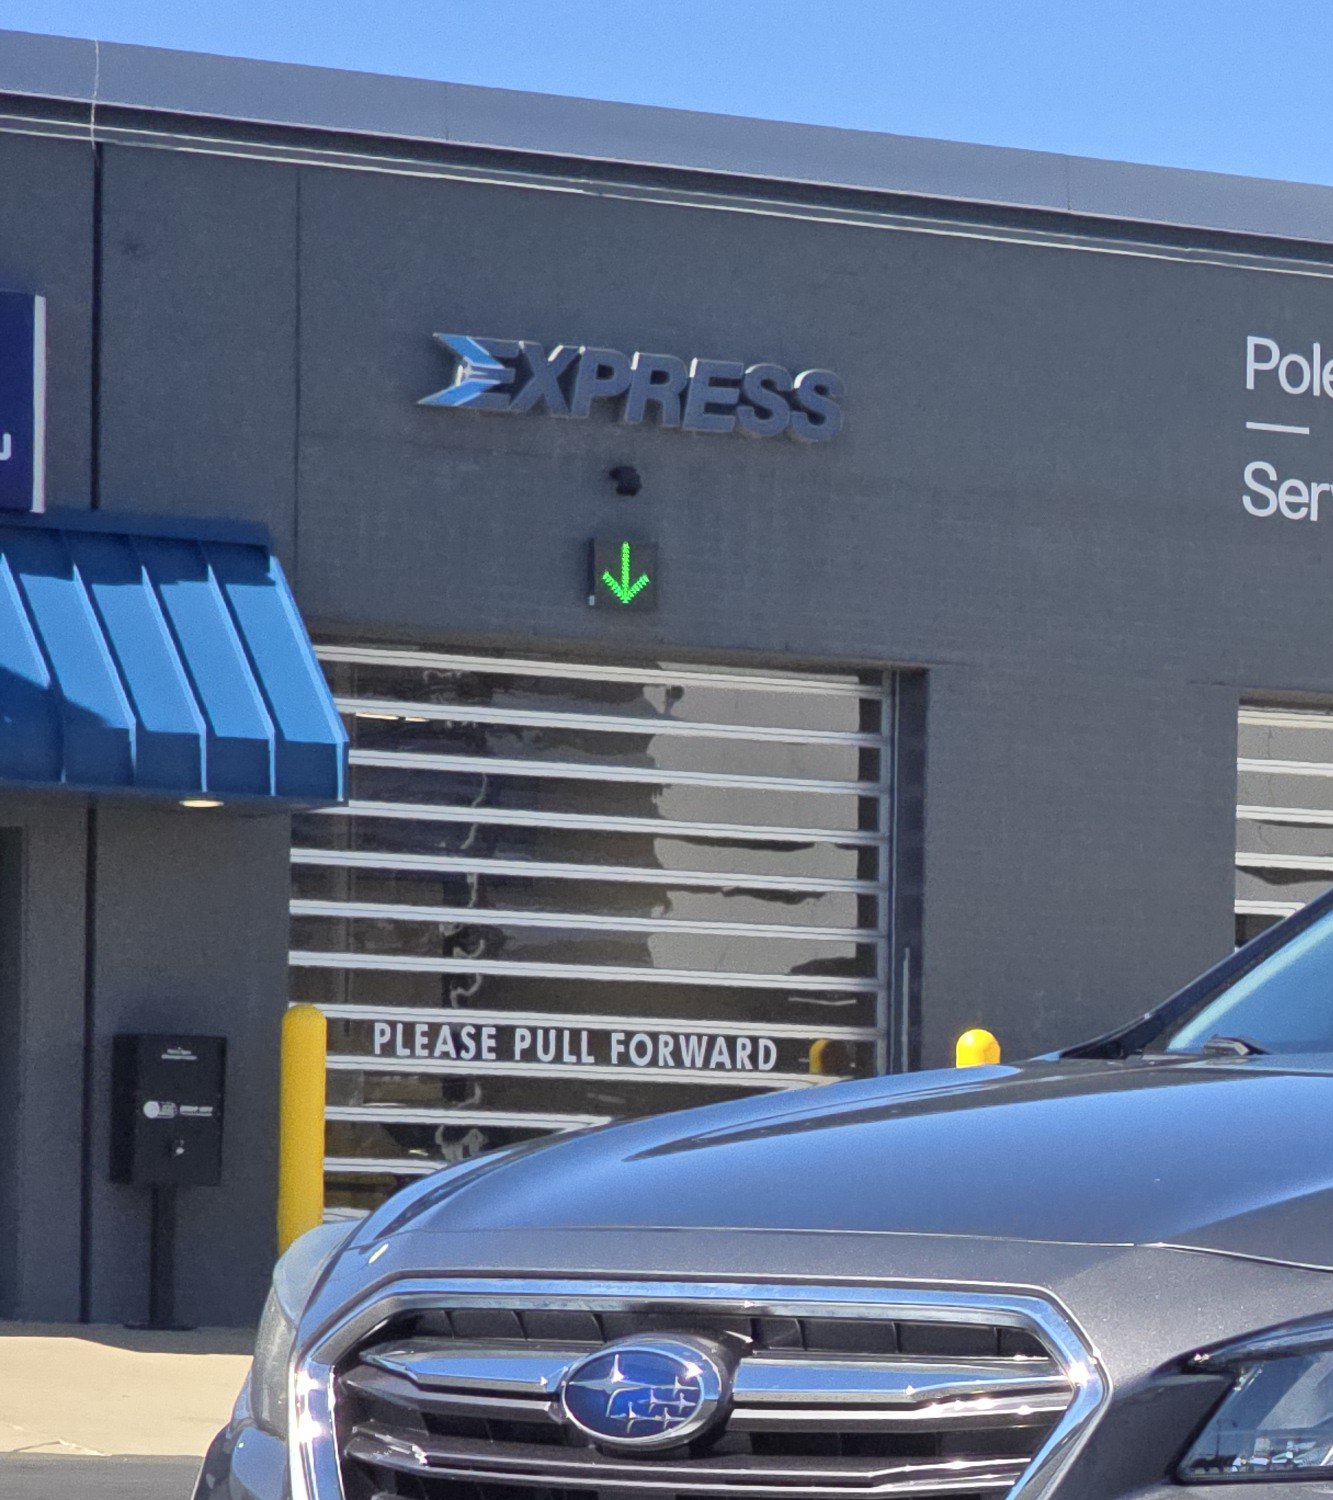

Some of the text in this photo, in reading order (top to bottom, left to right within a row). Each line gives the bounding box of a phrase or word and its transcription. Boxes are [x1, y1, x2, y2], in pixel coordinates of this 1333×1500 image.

[418, 333, 845, 443] EXPRESS
[373, 1022, 778, 1071] PLEASE PULL FORWARD
